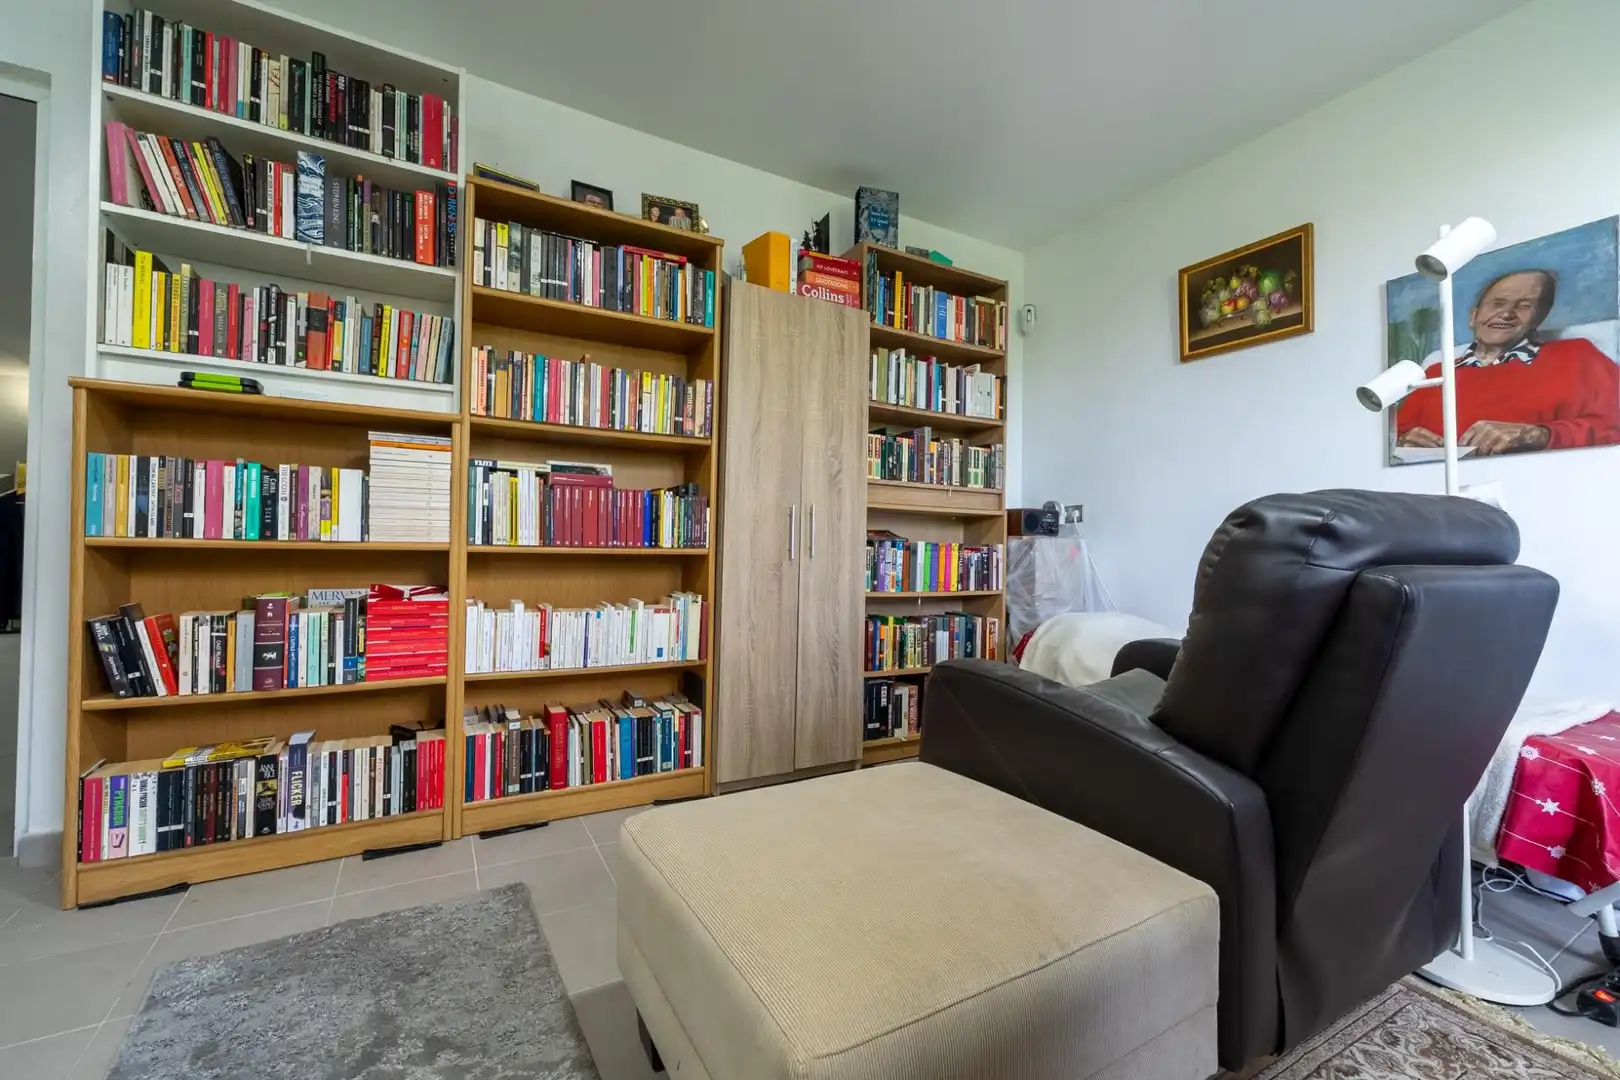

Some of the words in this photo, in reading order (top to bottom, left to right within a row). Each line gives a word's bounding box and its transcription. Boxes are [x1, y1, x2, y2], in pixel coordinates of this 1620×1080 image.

[802, 284, 844, 304] Collins
[259, 763, 275, 773] ANNE
[290, 770, 303, 806] FLICKER
